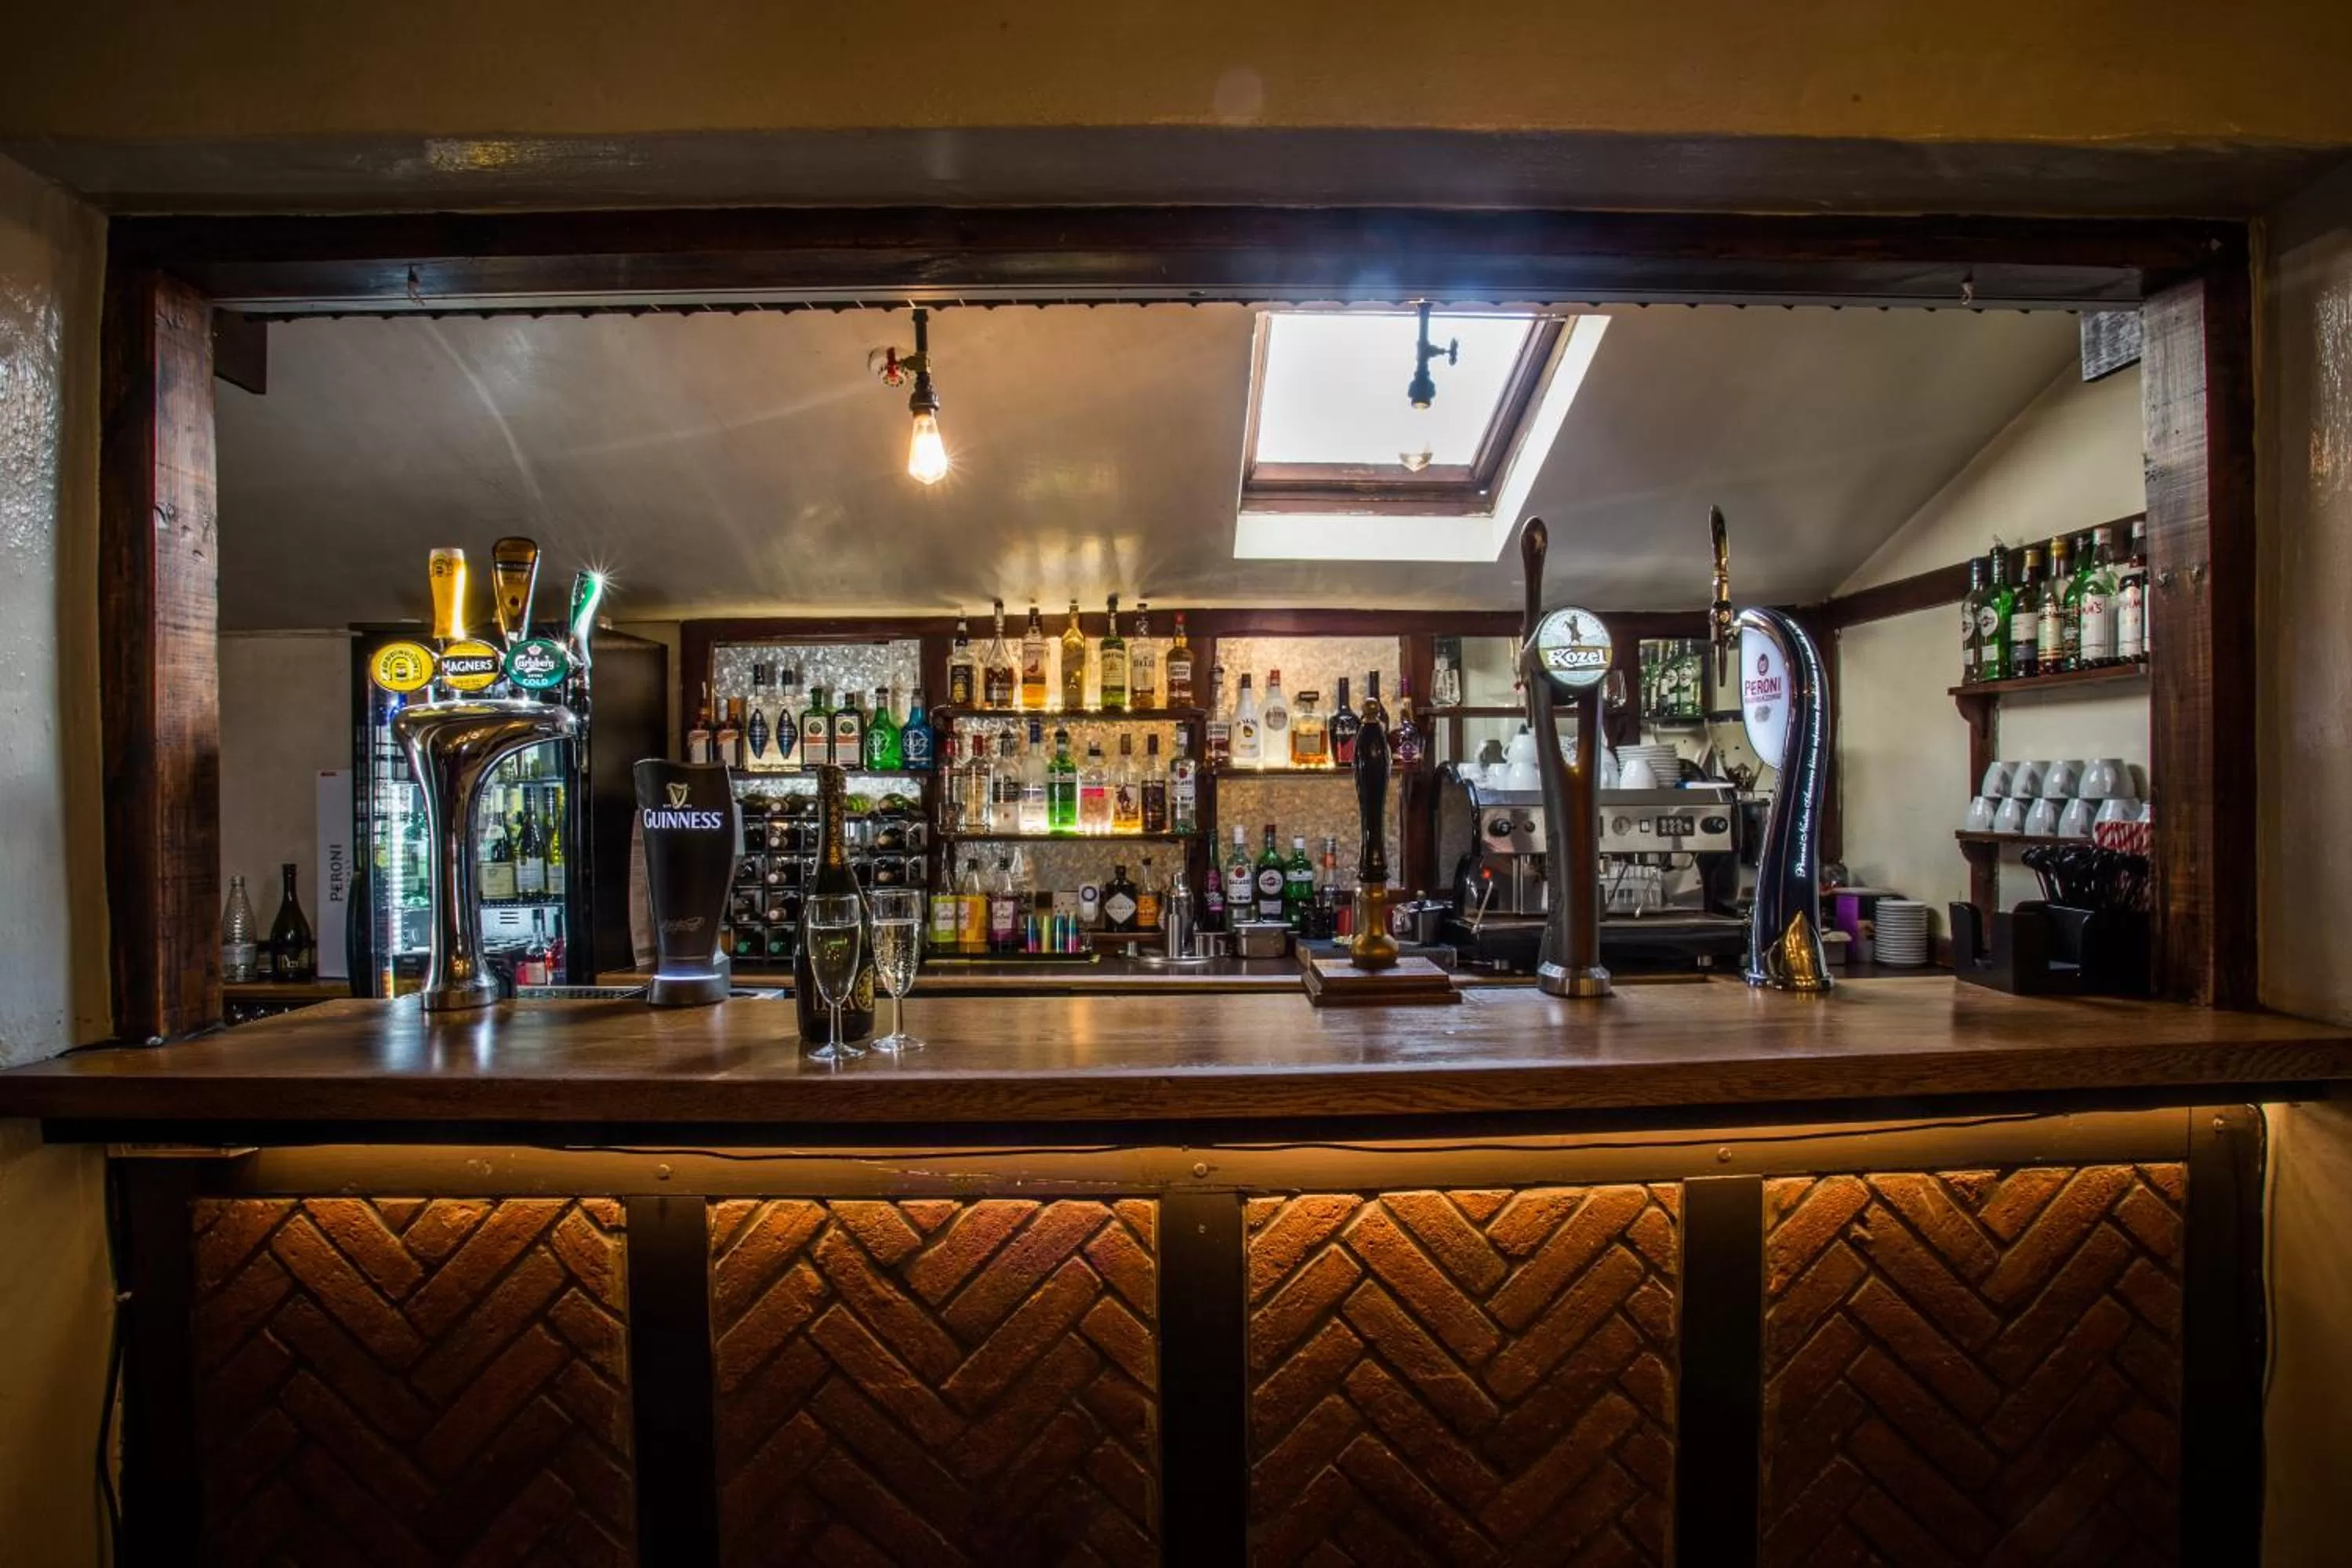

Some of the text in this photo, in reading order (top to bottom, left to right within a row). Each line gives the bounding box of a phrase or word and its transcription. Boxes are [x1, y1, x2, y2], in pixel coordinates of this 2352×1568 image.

[441, 659, 493, 673] MAGNERS
[514, 655, 554, 672] Carlsberg
[1548, 648, 1607, 668] Kozel
[1744, 677, 1782, 695] PERONI
[644, 808, 722, 829] GUINNESS
[329, 844, 343, 902] PERONI
